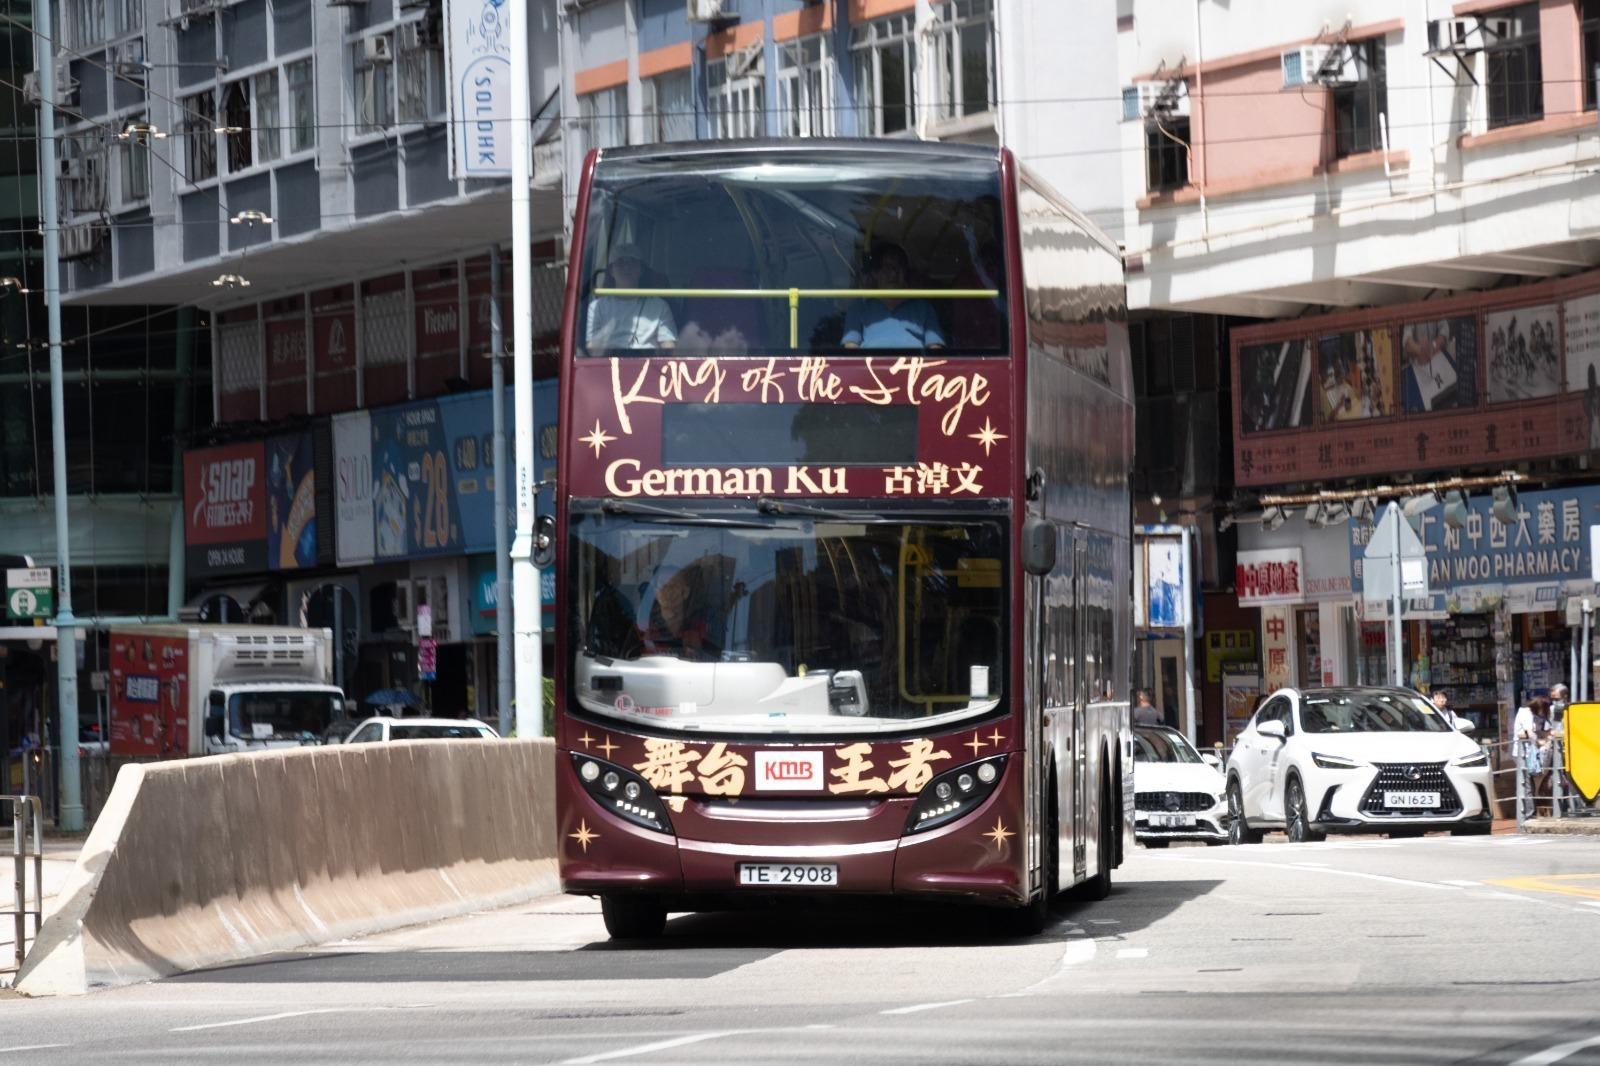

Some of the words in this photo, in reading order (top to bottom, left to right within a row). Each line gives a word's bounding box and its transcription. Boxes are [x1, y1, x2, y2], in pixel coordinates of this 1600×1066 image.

[610, 357, 726, 435] King
[741, 357, 786, 404] of
[790, 357, 844, 402] the
[849, 357, 990, 436] Stage
[604, 458, 775, 497] German
[784, 466, 848, 495] Ku
[882, 461, 984, 495] 古淖文
[1454, 555, 1490, 580] WOO
[1494, 547, 1581, 577] PHARMACY
[632, 737, 748, 813] 舞台
[765, 761, 814, 781] KMB
[828, 737, 953, 794] 王者
[1391, 795, 1405, 805] GN
[1408, 795, 1434, 805] 1623
[743, 866, 770, 883] TE
[779, 866, 833, 883] 2908
